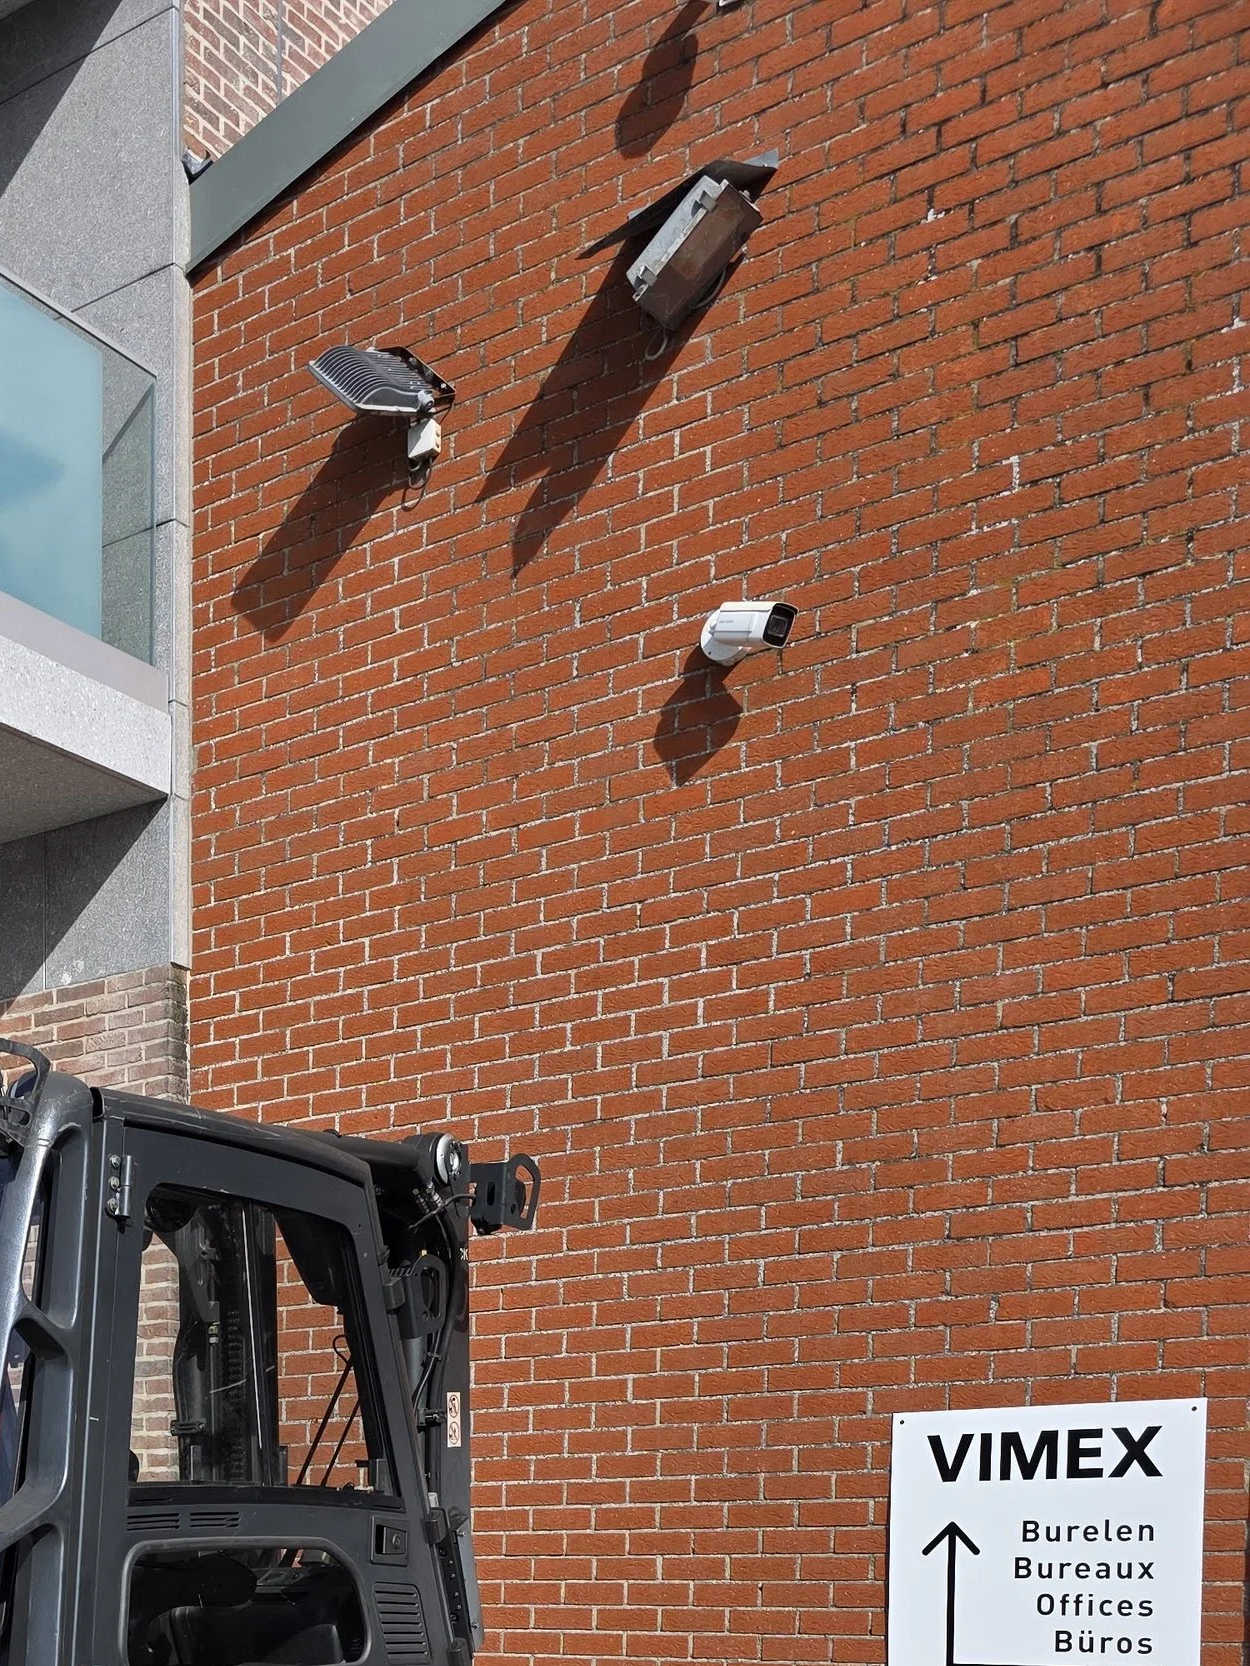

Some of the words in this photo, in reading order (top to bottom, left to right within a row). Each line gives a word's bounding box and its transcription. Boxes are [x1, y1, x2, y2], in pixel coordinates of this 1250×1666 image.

[927, 1426, 1163, 1482] VIMEX
[1022, 1519, 1155, 1542] Burelen
[1014, 1556, 1155, 1580] Bureaux
[1036, 1593, 1154, 1616] Offices
[1054, 1630, 1153, 1655] Büros
